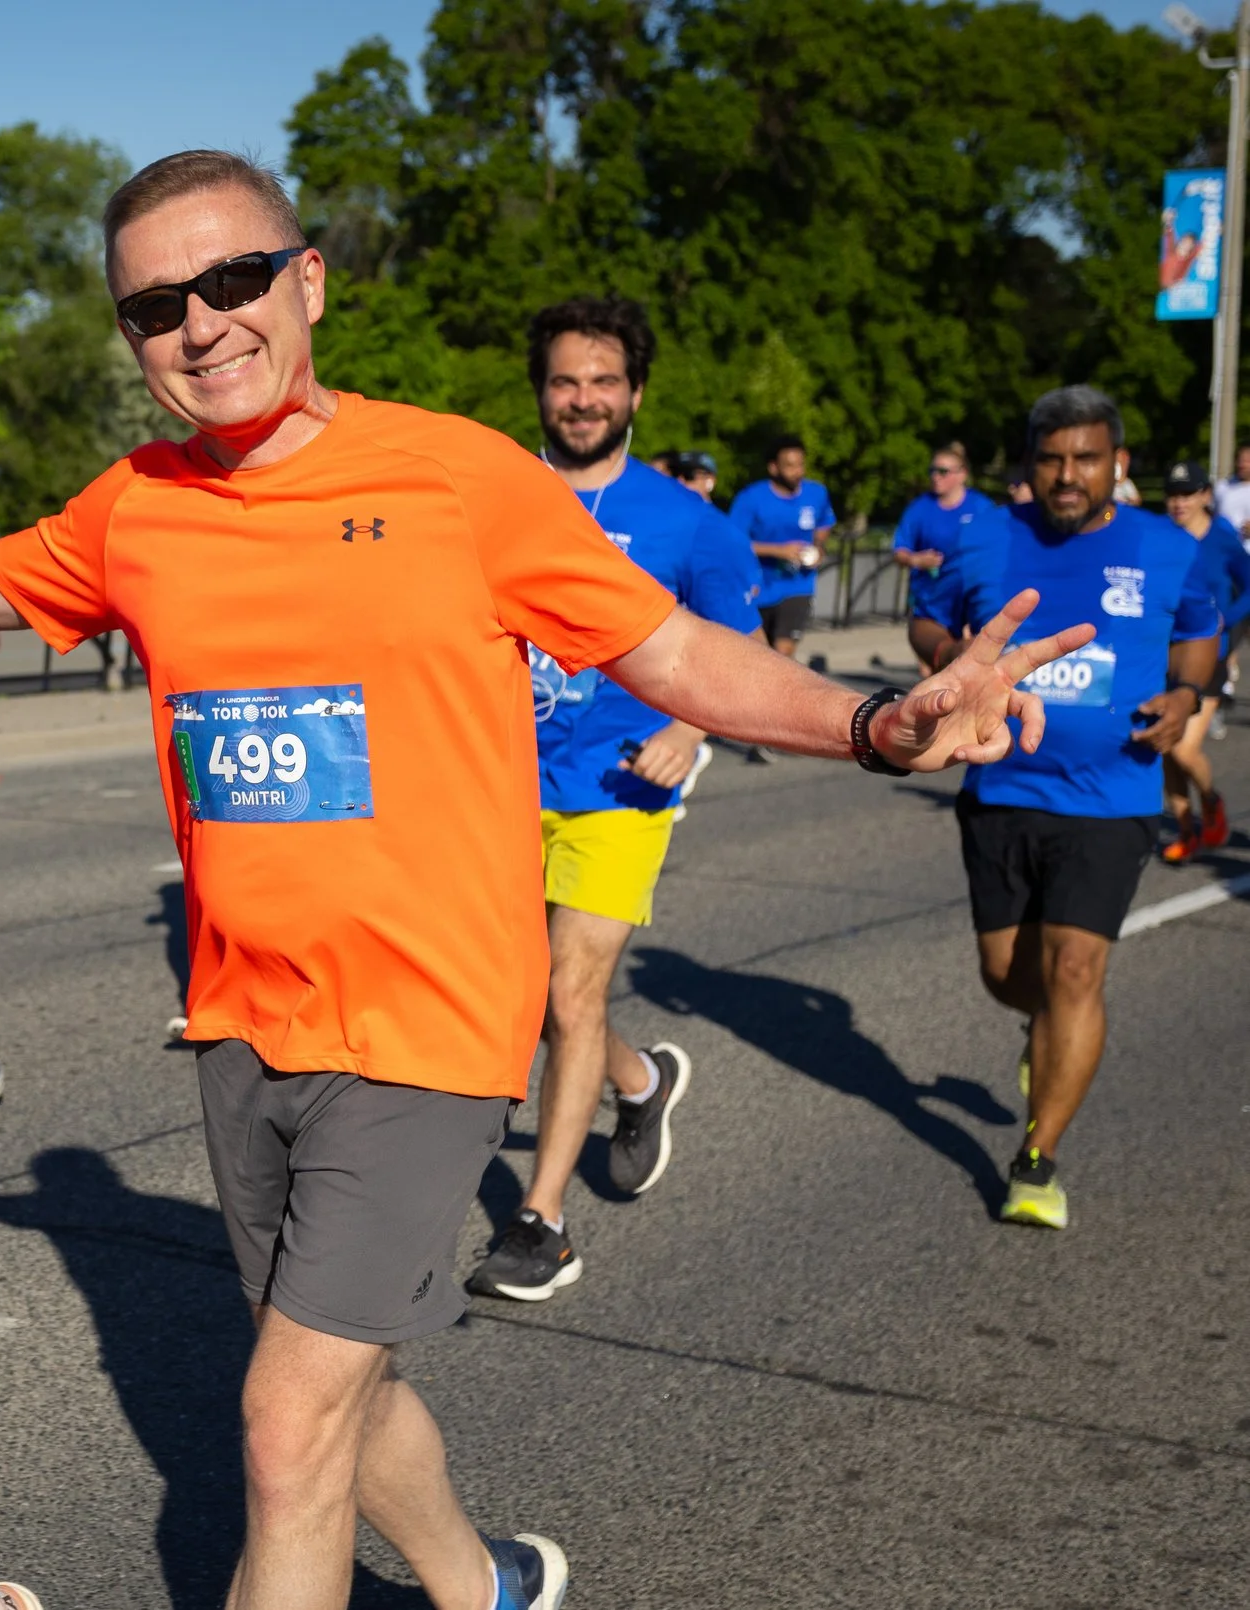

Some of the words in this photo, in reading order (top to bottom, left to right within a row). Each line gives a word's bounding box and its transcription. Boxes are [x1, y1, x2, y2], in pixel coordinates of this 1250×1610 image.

[226, 696, 250, 704] UNDER
[251, 695, 280, 703] ARMOUR
[211, 706, 242, 721] TOR
[260, 705, 288, 719] 10K
[208, 733, 307, 784] 499
[231, 790, 286, 806] DMITRI
